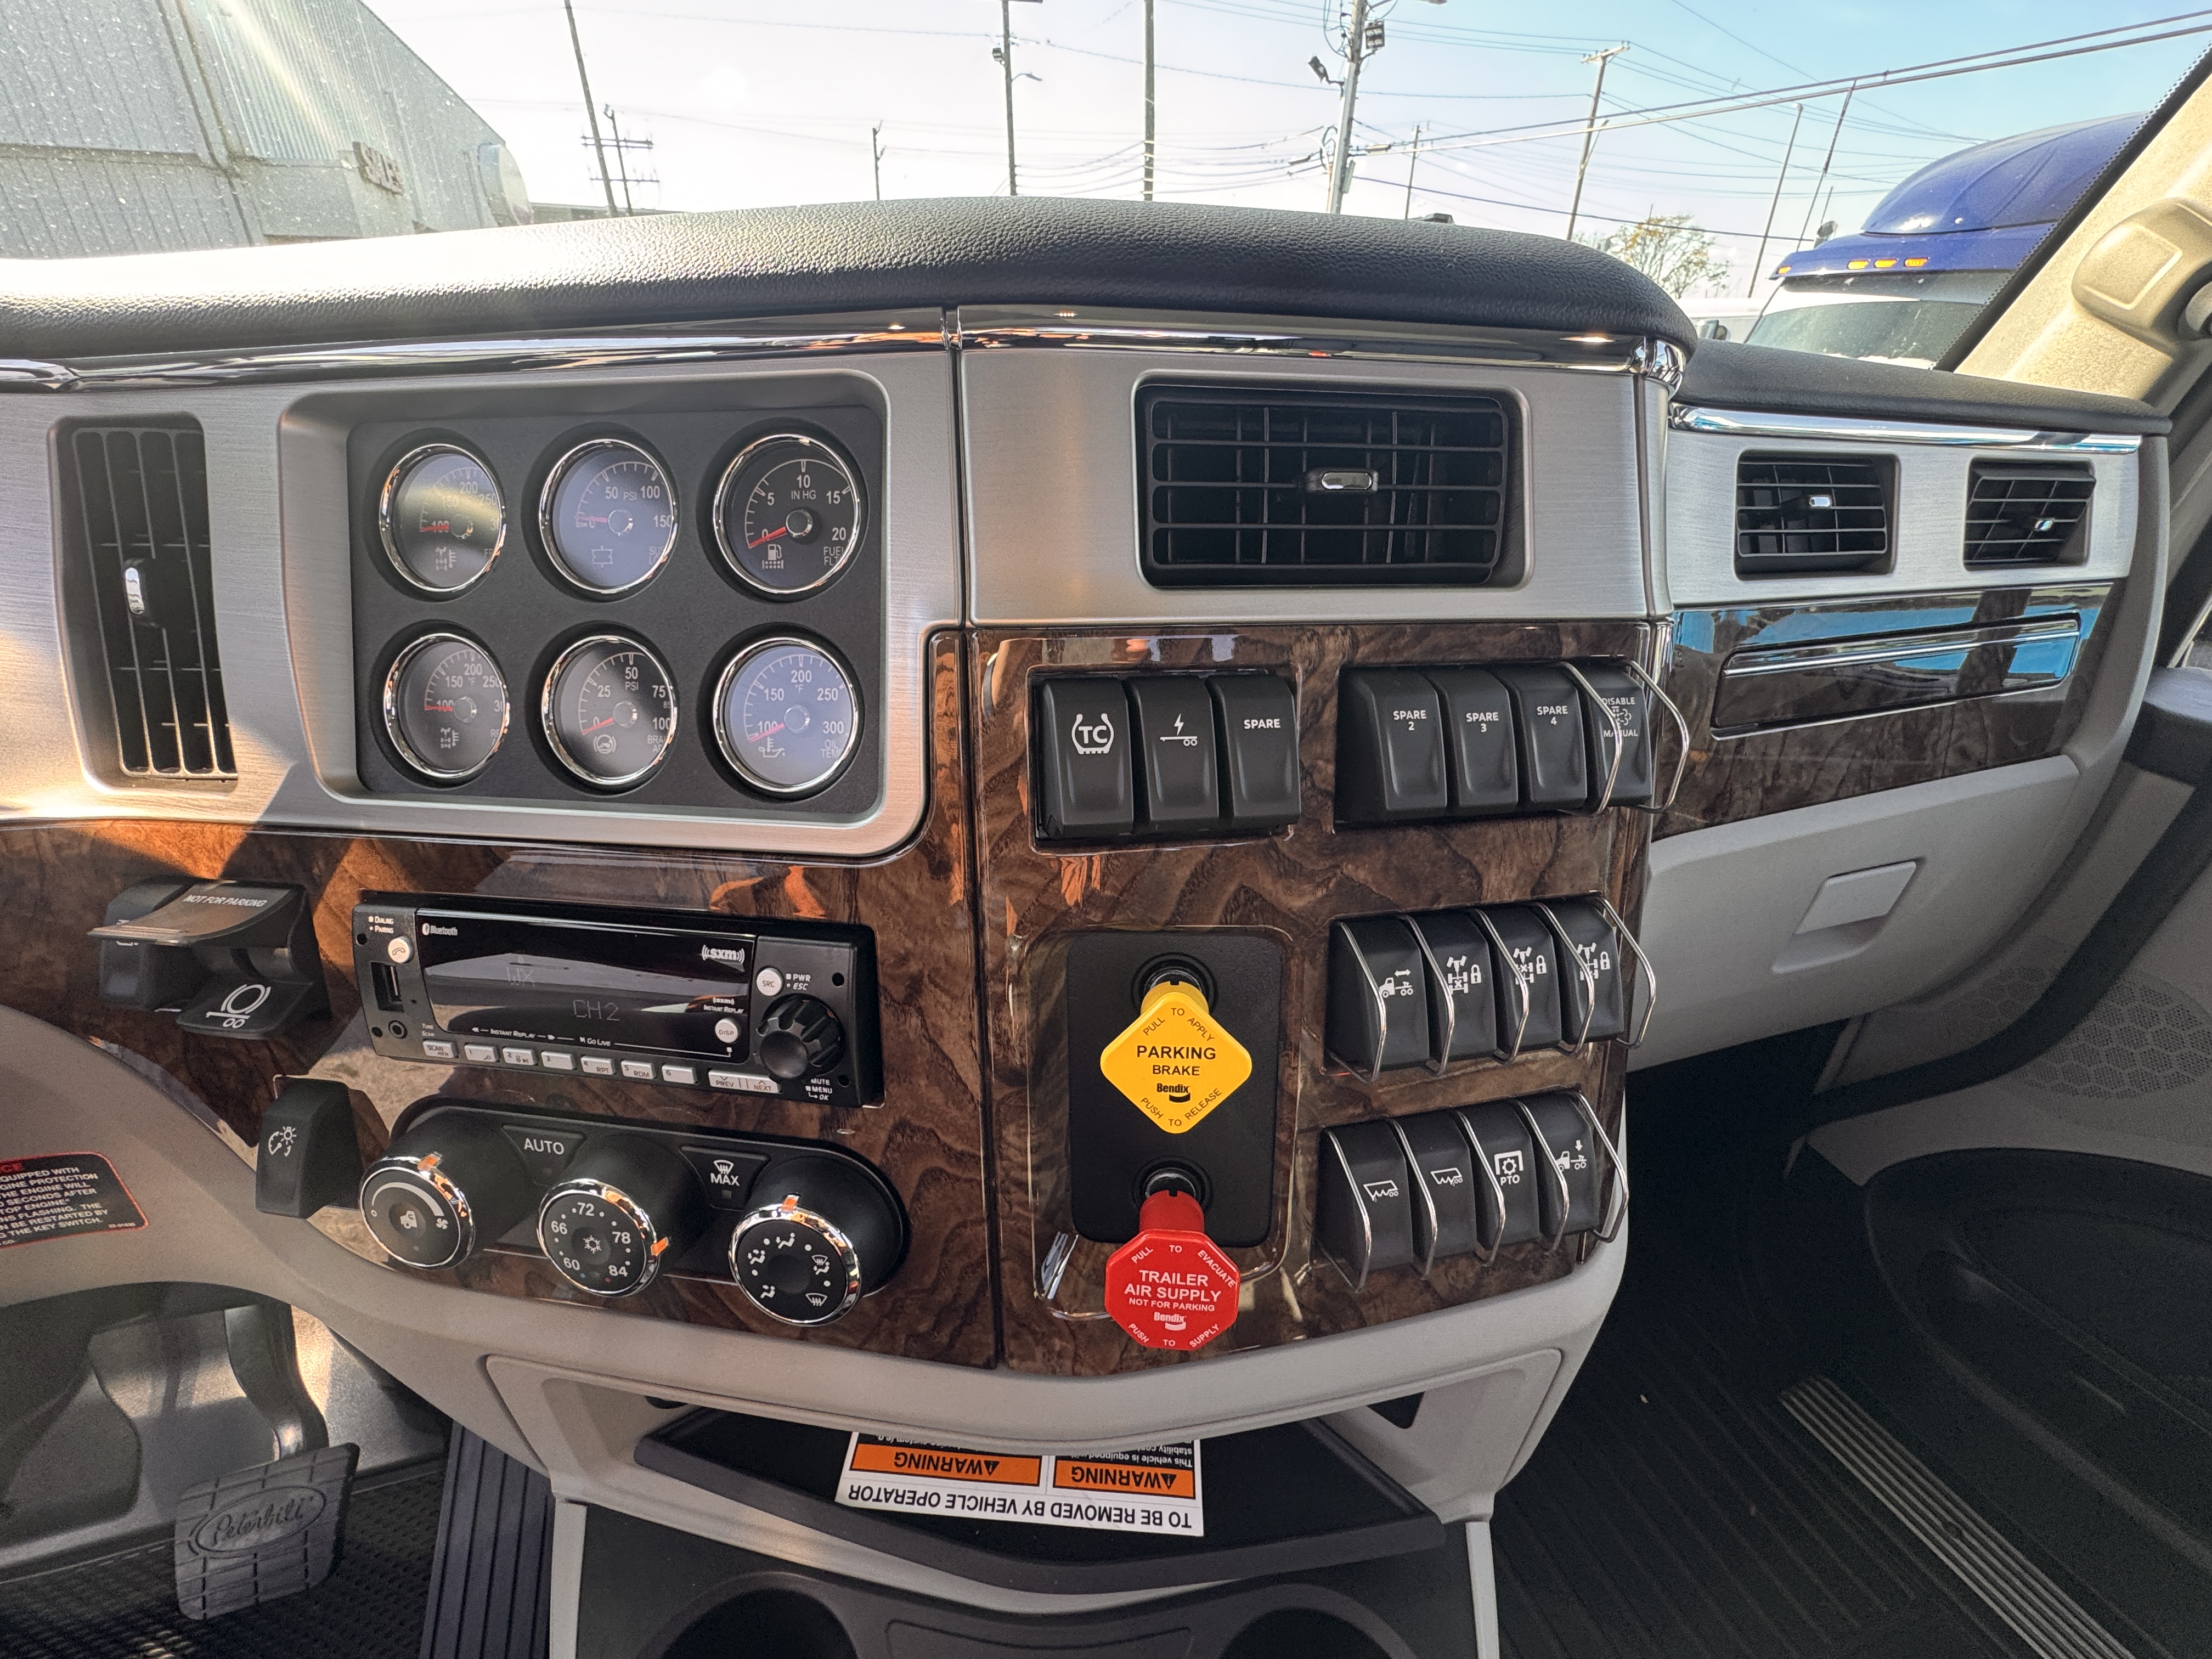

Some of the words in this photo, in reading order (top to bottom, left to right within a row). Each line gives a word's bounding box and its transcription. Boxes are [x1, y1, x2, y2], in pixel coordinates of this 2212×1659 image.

[460, 482, 478, 493] 200
[797, 475, 811, 488] 10
[605, 487, 618, 499] 50
[623, 492, 637, 500] PSI
[640, 486, 660, 498] 100
[791, 491, 800, 499] IN
[803, 490, 816, 499] HG
[826, 491, 840, 504] 15
[442, 495, 459, 507] 150
[768, 492, 775, 505] 5
[832, 527, 847, 540] 20
[464, 664, 482, 675] 200
[625, 667, 639, 679] 50
[445, 676, 463, 687] 150
[791, 670, 812, 682] 200
[597, 685, 611, 697] 25
[625, 682, 639, 691] PSI
[652, 685, 665, 698] 75
[764, 688, 785, 701] 150
[817, 688, 838, 701] 250
[1601, 697, 1635, 706] DISABLE
[1393, 710, 1426, 721] SPARE
[1466, 712, 1499, 722] SPARE
[1537, 706, 1568, 716] SPARE
[758, 721, 778, 733] 100
[1244, 719, 1280, 729] SPARE
[1408, 722, 1415, 731] 2
[1550, 716, 1558, 726] 4
[823, 721, 844, 734] 300
[1480, 724, 1487, 732] 3
[1079, 726, 1107, 744] TC
[825, 740, 838, 749] OIL
[183, 895, 207, 903] NOT
[202, 896, 227, 904] FOR
[222, 898, 268, 907] PARKING
[430, 925, 458, 936] Bluetooth
[793, 974, 811, 982] PWR
[573, 999, 620, 1022] CH2
[1143, 1018, 1165, 1036] PULL
[1171, 1007, 1184, 1015] TO
[1187, 1018, 1215, 1041] APPLY
[1137, 1045, 1216, 1059] PARKING
[1153, 1065, 1200, 1076] BRAKE
[812, 1086, 833, 1094] MENU
[1156, 1083, 1189, 1093] Bendix
[1140, 1097, 1164, 1119] PUSH
[1184, 1088, 1222, 1120] RELEASE
[523, 1138, 565, 1155] AUTO
[51, 1167, 80, 1175] WITH
[29, 1173, 98, 1186] PROTECTION
[710, 1173, 740, 1186] MAX
[1500, 1174, 1520, 1186] PTO
[20, 1183, 63, 1195] ENGINE
[5, 1192, 61, 1206] SECONDS
[64, 1188, 97, 1197] AFTER
[577, 1202, 595, 1216] 72
[28, 1210, 93, 1225] RESTARTED
[7, 1227, 32, 1237] THE
[33, 1223, 55, 1232] KEY
[551, 1220, 568, 1234] 66
[612, 1232, 631, 1244] 78
[563, 1257, 580, 1271] 60
[1131, 1247, 1154, 1263] PULL
[1169, 1244, 1182, 1252] TO
[1198, 1250, 1236, 1288] EVACUATE
[608, 1265, 628, 1277] 84
[1139, 1269, 1208, 1286] TRAILER
[1124, 1284, 1152, 1297] AIR
[1156, 1286, 1221, 1302] SUPPLY
[1128, 1297, 1148, 1306] NOT
[1151, 1300, 1170, 1308] FOR
[1173, 1302, 1215, 1312] PARKING
[1154, 1312, 1186, 1323] Bendix
[1128, 1323, 1150, 1343] PUSH
[1189, 1324, 1220, 1348] SUPPLY
[1158, 1445, 1193, 1455] stability
[894, 1452, 983, 1475] WARNING
[1131, 1454, 1139, 1463] is
[1141, 1454, 1173, 1466] vehicle
[1174, 1458, 1193, 1468] This
[1071, 1466, 1162, 1489] WARNING
[848, 1485, 941, 1508] OPERATOR
[945, 1494, 1018, 1514] VEHICLE
[1021, 1500, 1045, 1516] BY
[1051, 1502, 1136, 1524] REMOVED
[1141, 1509, 1163, 1526] BE
[1169, 1511, 1192, 1528] TO
